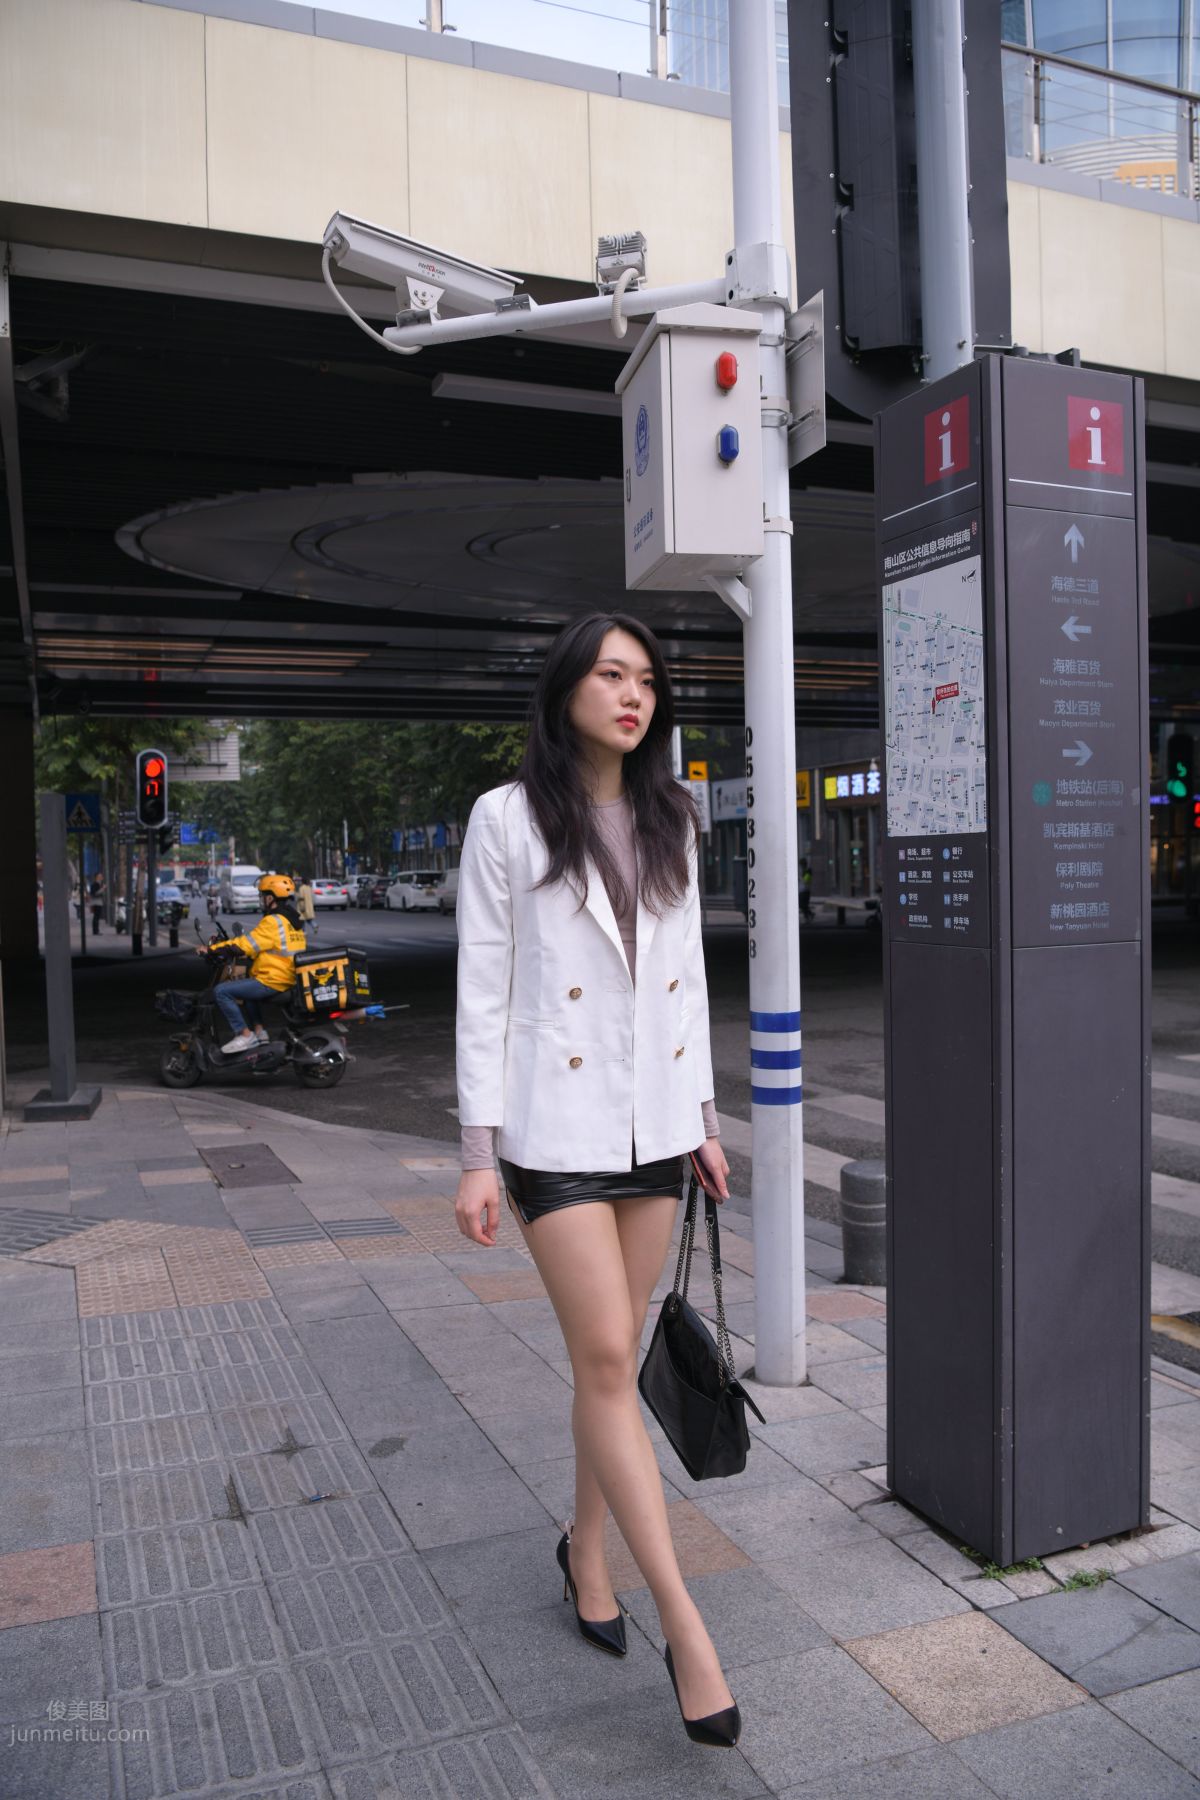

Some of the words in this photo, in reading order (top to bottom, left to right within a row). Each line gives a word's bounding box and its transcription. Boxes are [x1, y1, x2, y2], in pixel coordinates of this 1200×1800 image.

[884, 528, 971, 570] 南山区公共信息导向指南
[931, 550, 957, 562] Information
[957, 545, 971, 554] Guide
[961, 575, 967, 583] N
[1051, 576, 1099, 594] 海德三道
[1053, 658, 1101, 676] 海雅百货
[1039, 677, 1058, 687] Haiya
[1059, 678, 1096, 689] Department
[1053, 699, 1101, 716] 茂业百货
[1061, 719, 1098, 729] Department
[1056, 779, 1125, 796] 地铁站(后海)
[1055, 799, 1074, 807] Metro
[1075, 799, 1097, 807] Station
[1043, 822, 1115, 838] 凯宾斯基酒店
[1053, 842, 1088, 850] Kempinski
[952, 870, 974, 879] 公交车站
[1055, 861, 1104, 878] 保利剧院
[1060, 882, 1075, 891] Poly
[1050, 902, 1110, 919] 新桃园酒店
